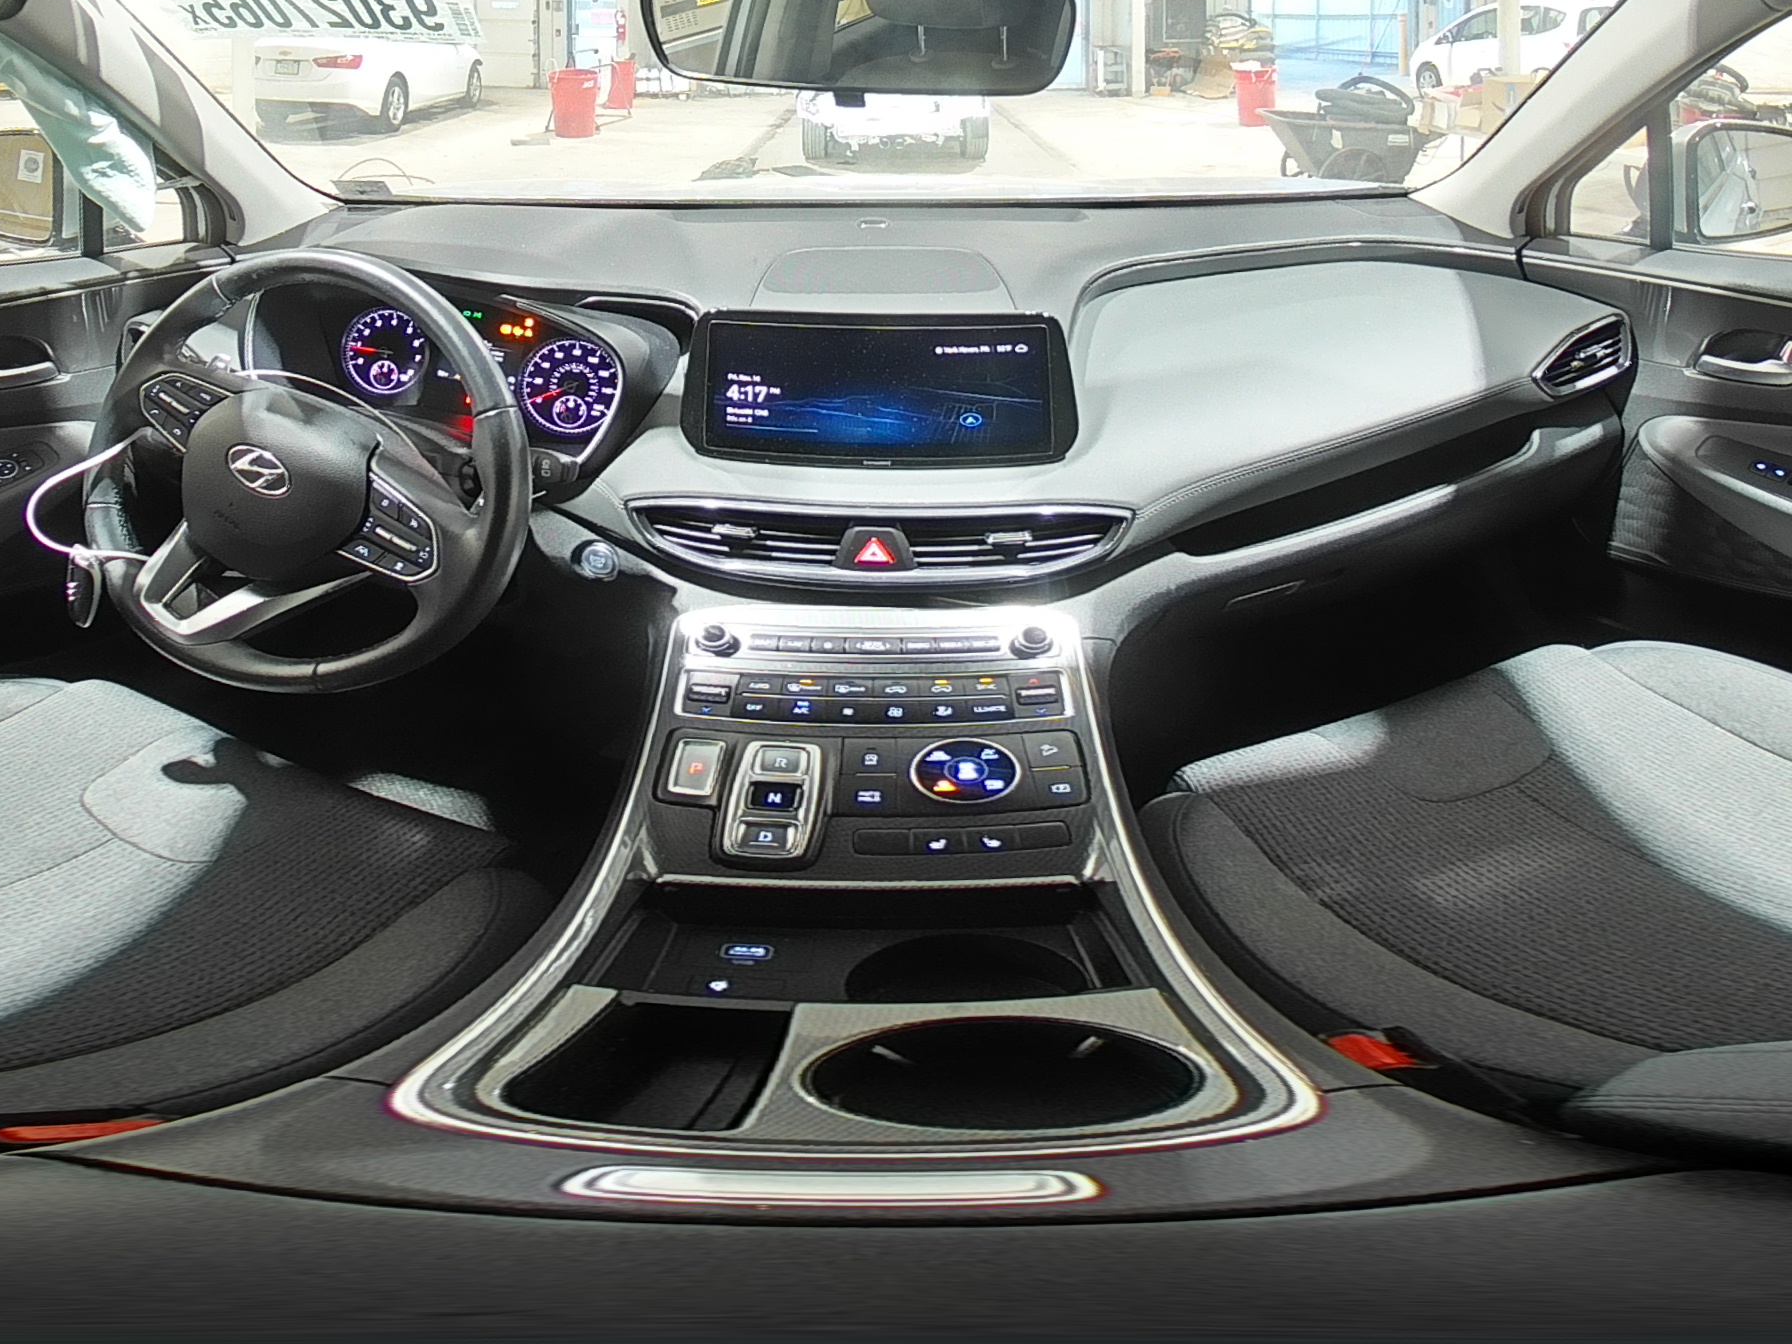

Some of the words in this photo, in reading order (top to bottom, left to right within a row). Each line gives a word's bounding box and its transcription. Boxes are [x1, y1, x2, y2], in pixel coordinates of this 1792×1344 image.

[726, 383, 768, 403] 4:17
[688, 762, 704, 774] P
[774, 757, 789, 768] R
[767, 792, 782, 804] N
[758, 830, 773, 842] D
